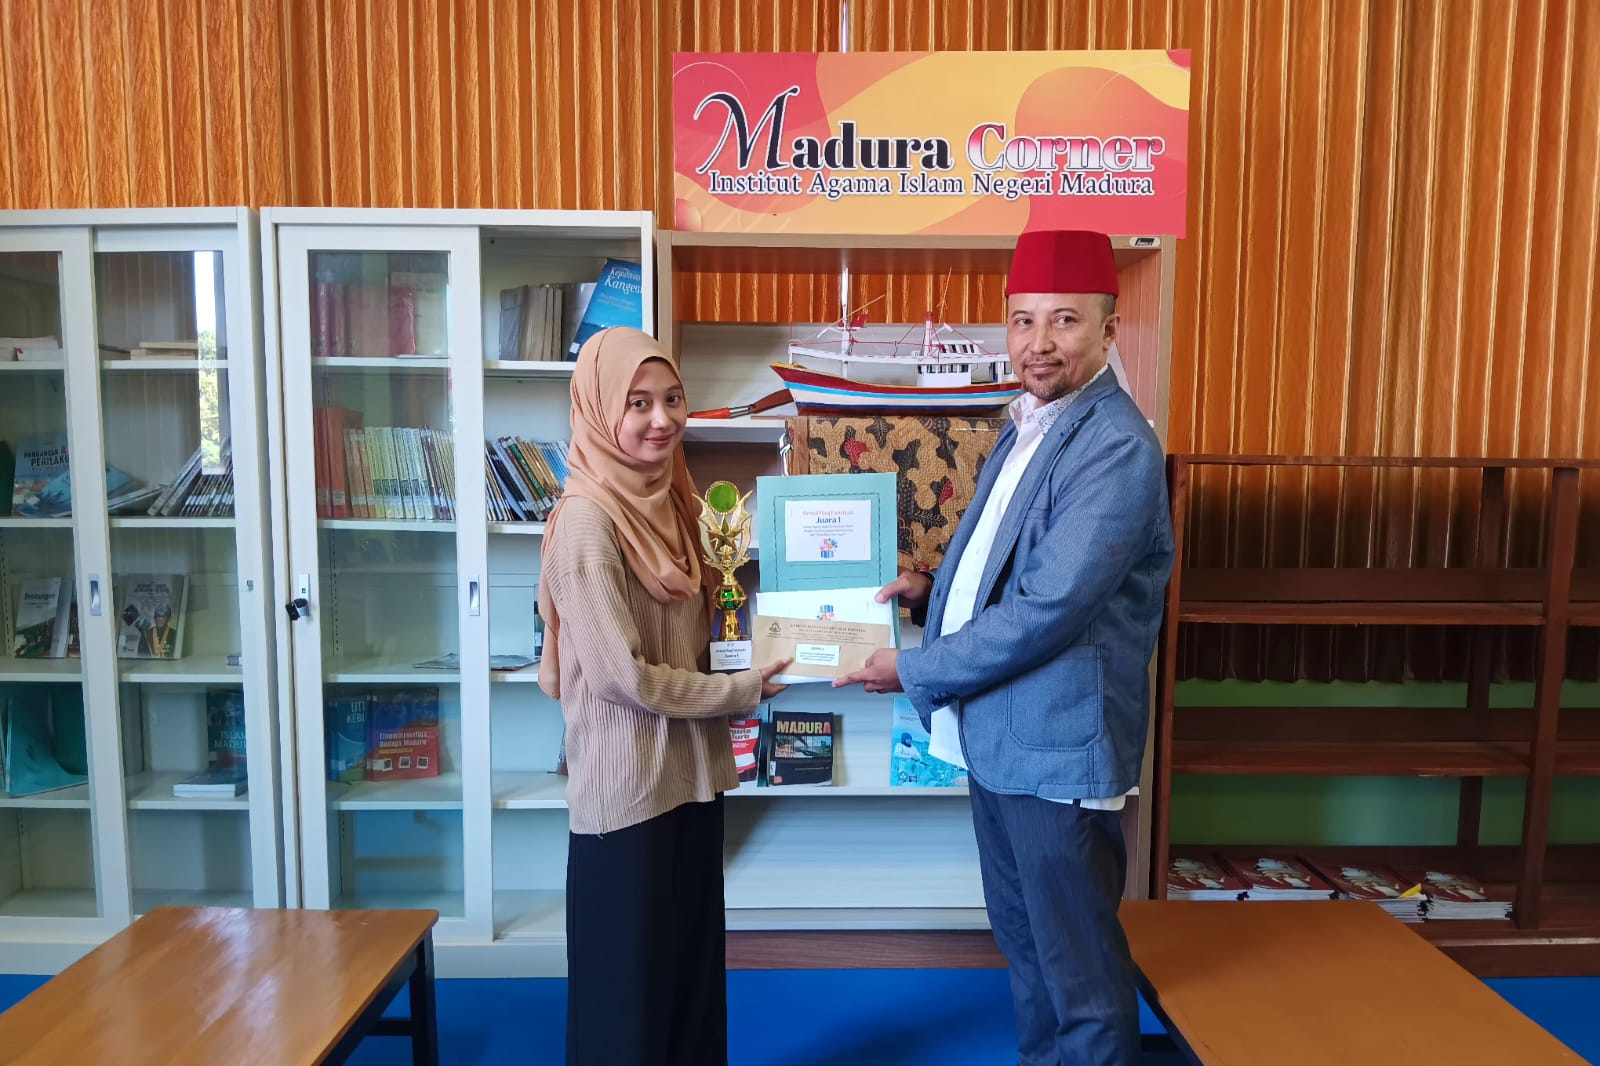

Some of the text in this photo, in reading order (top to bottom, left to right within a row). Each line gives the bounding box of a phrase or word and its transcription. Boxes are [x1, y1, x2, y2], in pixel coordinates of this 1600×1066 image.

[693, 86, 1164, 173] Madura Corner
[709, 172, 1153, 199] Institut Agama Islam Negeri Madura
[604, 275, 642, 295] Kangea
[815, 516, 837, 524] Juara
[776, 720, 832, 734] MADURA
